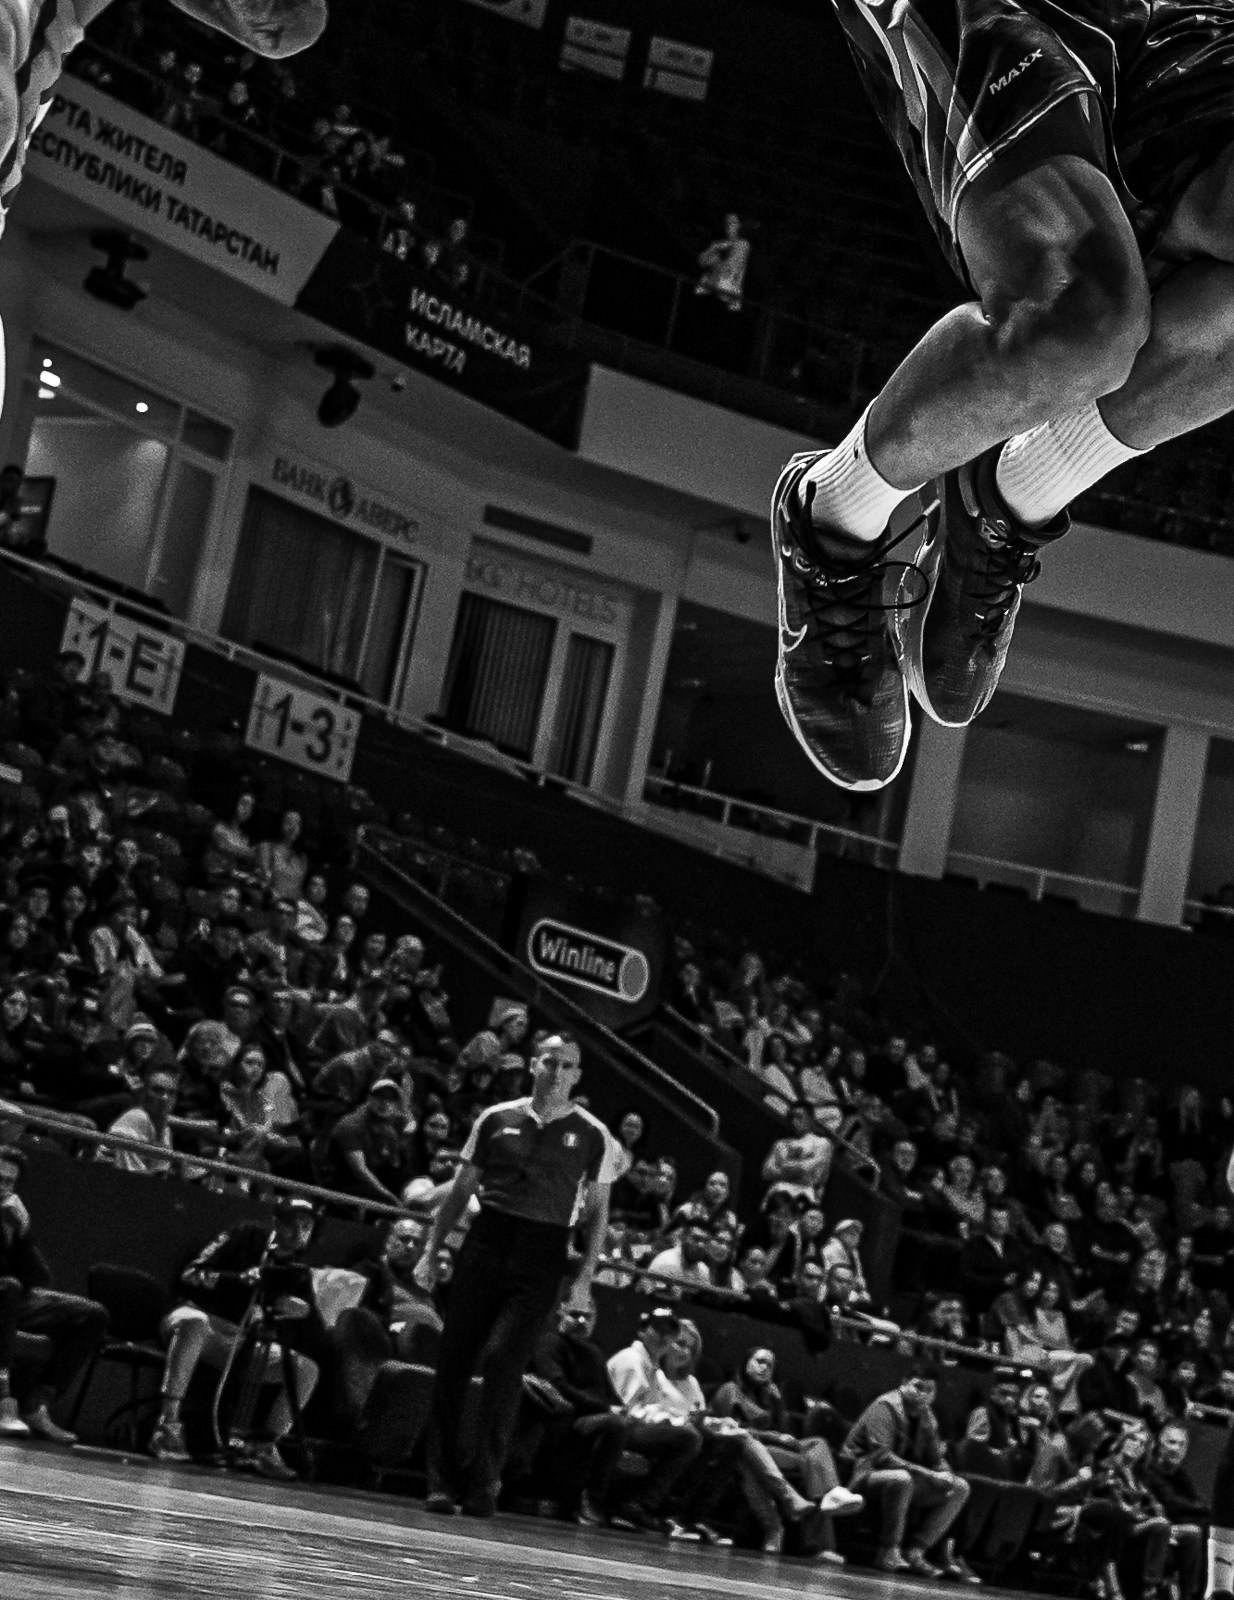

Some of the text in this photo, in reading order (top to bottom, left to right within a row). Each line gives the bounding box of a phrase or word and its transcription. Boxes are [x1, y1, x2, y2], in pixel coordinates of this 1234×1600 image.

[51, 94, 188, 186] РТА ЖИТЕЛЯ
[29, 127, 280, 277] ЕСПУБЛИКИ ТАТАРСТАН
[403, 323, 468, 375] КАРТА
[407, 287, 533, 371] ИСЛАМСКАЯ
[537, 929, 618, 986] Winline
